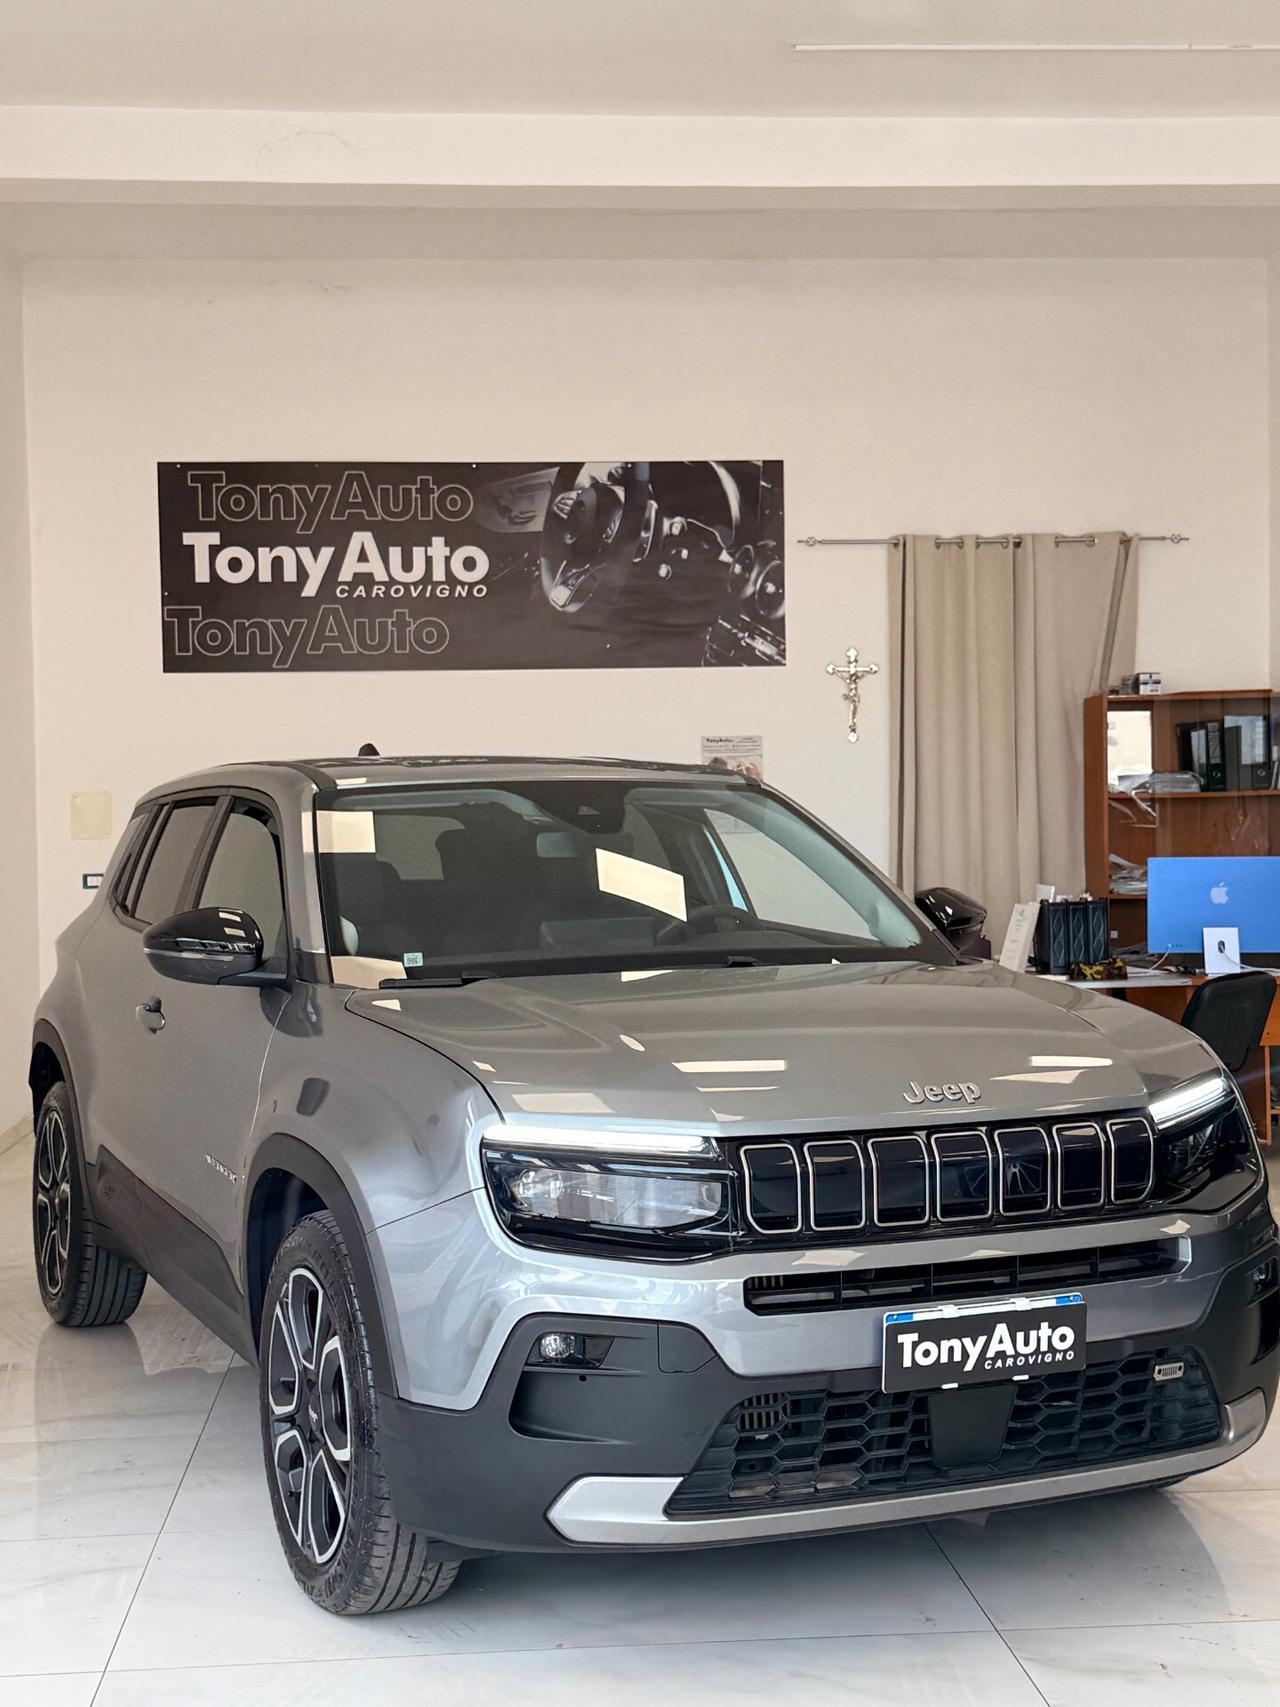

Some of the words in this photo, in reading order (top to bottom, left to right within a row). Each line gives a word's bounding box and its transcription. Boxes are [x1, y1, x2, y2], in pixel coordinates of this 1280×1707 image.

[188, 471, 474, 534] TonyAuto
[182, 531, 490, 597] TonyAuto
[335, 584, 488, 598] CAROVIGNO
[164, 605, 450, 668] TonyAuto
[903, 1080, 981, 1104] Jeep
[897, 1322, 1075, 1372] TonyAuto
[984, 1350, 1075, 1370] CAROVIGNO
